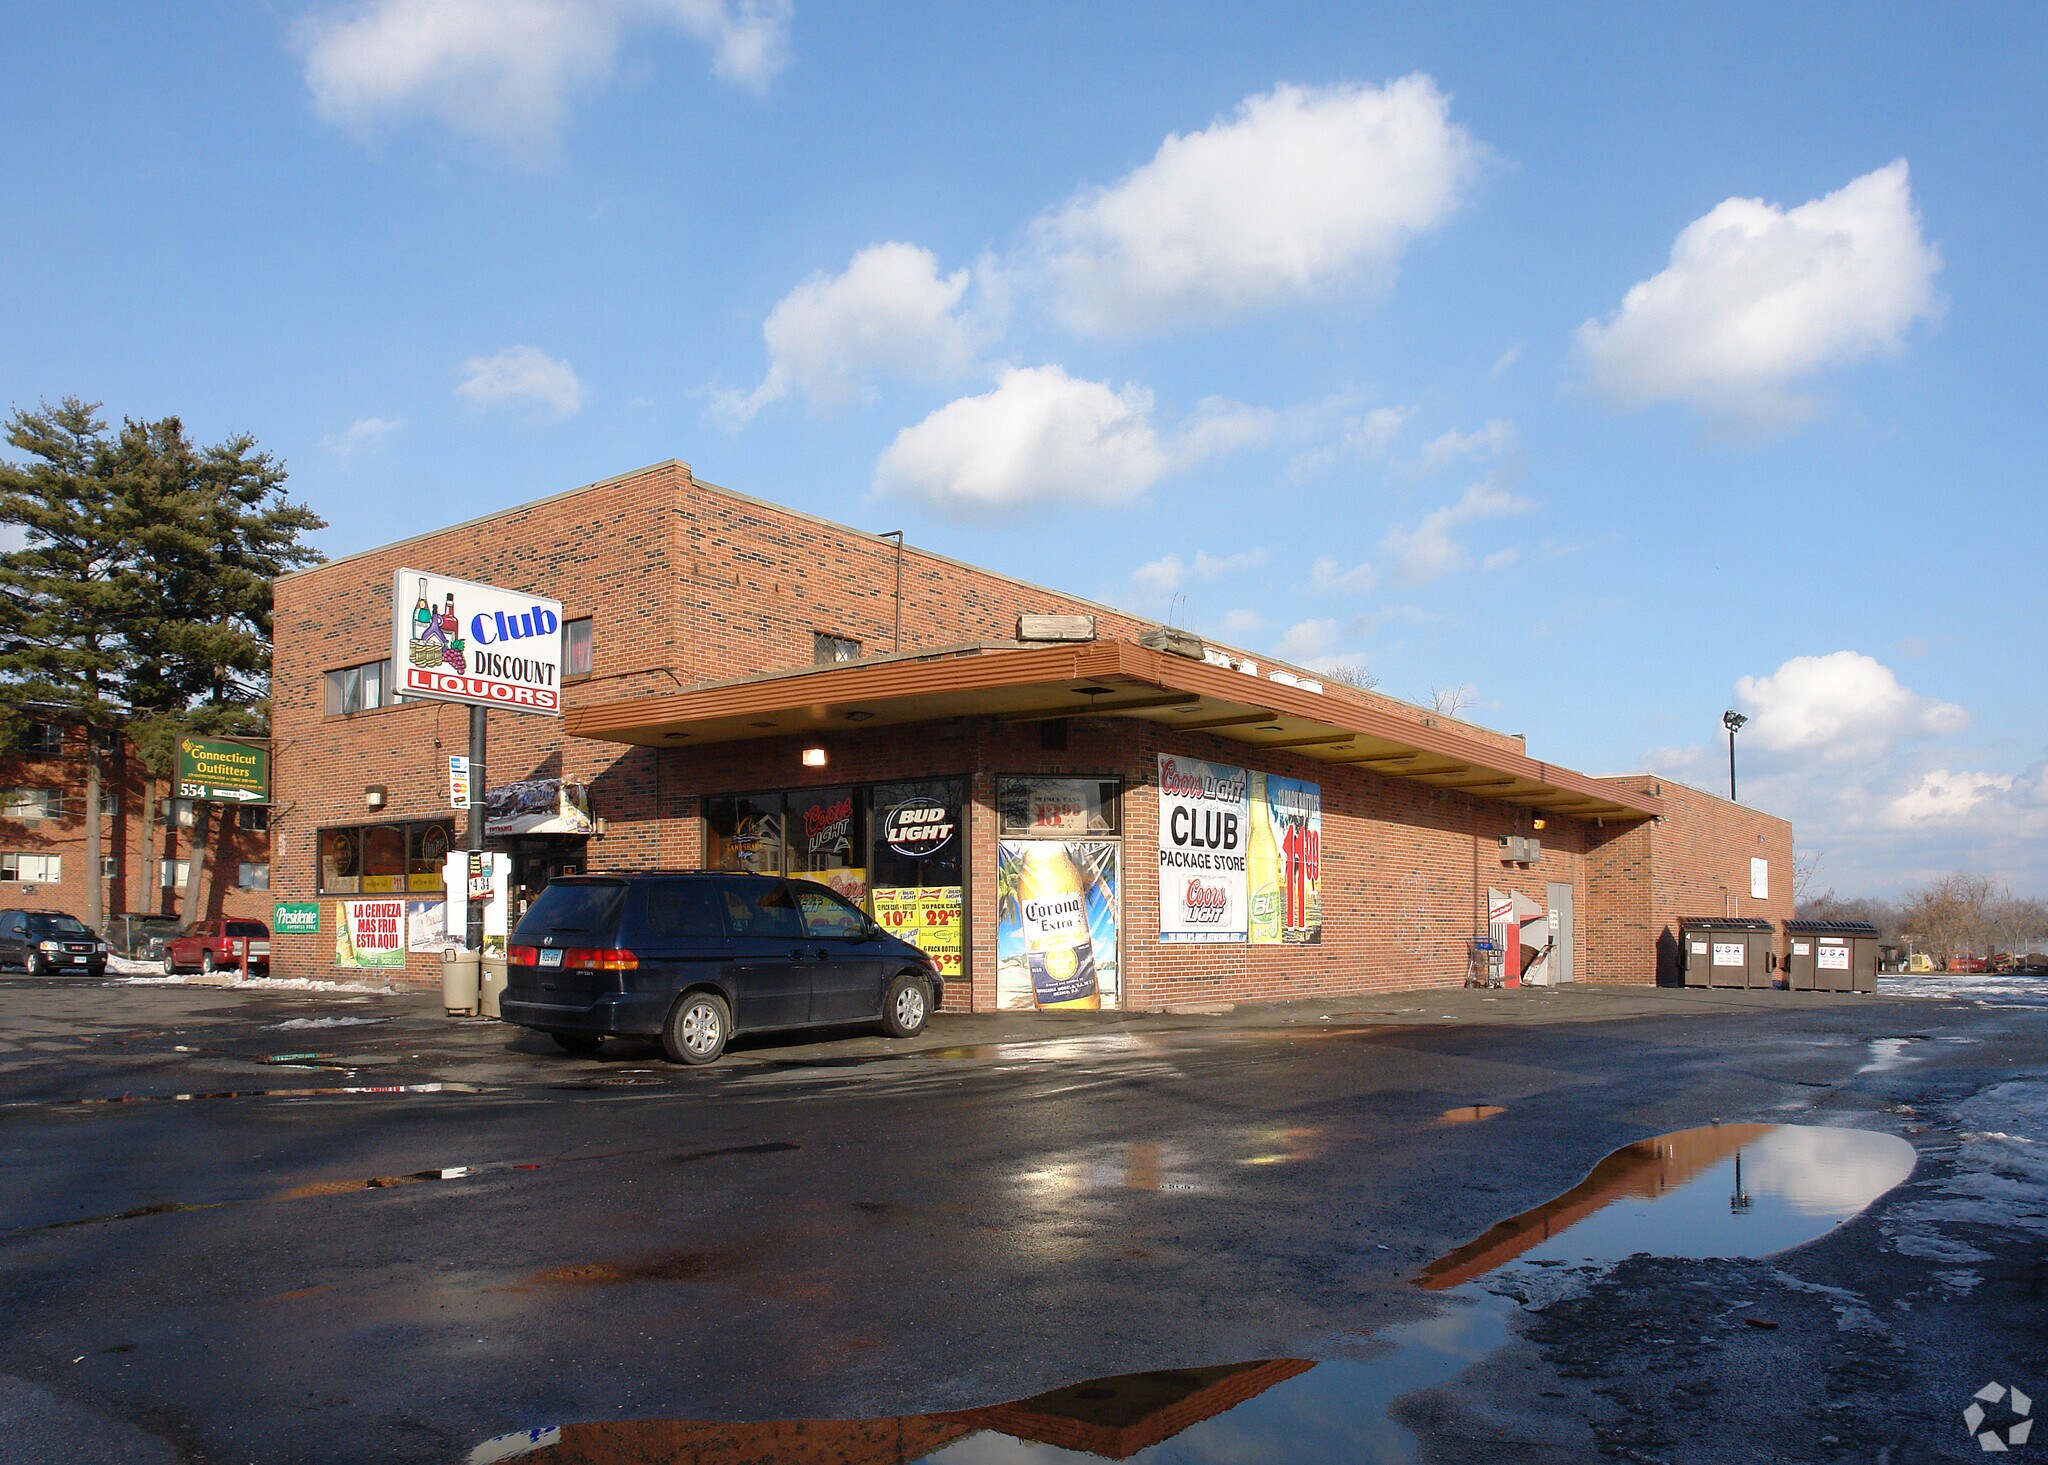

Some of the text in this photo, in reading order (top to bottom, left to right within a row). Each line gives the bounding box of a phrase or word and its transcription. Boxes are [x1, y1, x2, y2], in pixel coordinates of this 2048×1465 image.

[471, 606, 558, 645] Club
[475, 651, 556, 686] DISCOUNT
[410, 671, 555, 707] LIQUORS
[191, 748, 257, 765] Connecticut
[196, 762, 250, 777] Outfitters
[180, 783, 206, 798] 554
[1161, 759, 1246, 804] Coors LIGHT
[803, 798, 854, 839] Coors
[898, 808, 946, 825] BUD
[809, 818, 850, 854] LIGHT
[888, 824, 954, 844] LIGHT
[1171, 805, 1238, 850] CLUB
[1160, 850, 1246, 872] PACKAGE STORE
[828, 875, 867, 898] Coors
[1186, 879, 1227, 909] Coors
[276, 907, 317, 925] Presidente
[354, 903, 402, 918] LA CERVEZA
[1026, 899, 1080, 922] Corona
[1185, 907, 1225, 923] LIGHT
[358, 919, 397, 933] MAS FRIA
[1041, 919, 1073, 932] Extra
[356, 934, 376, 949] ESTA
[377, 934, 398, 950] AQUI
[941, 945, 961, 953] BOTTLES
